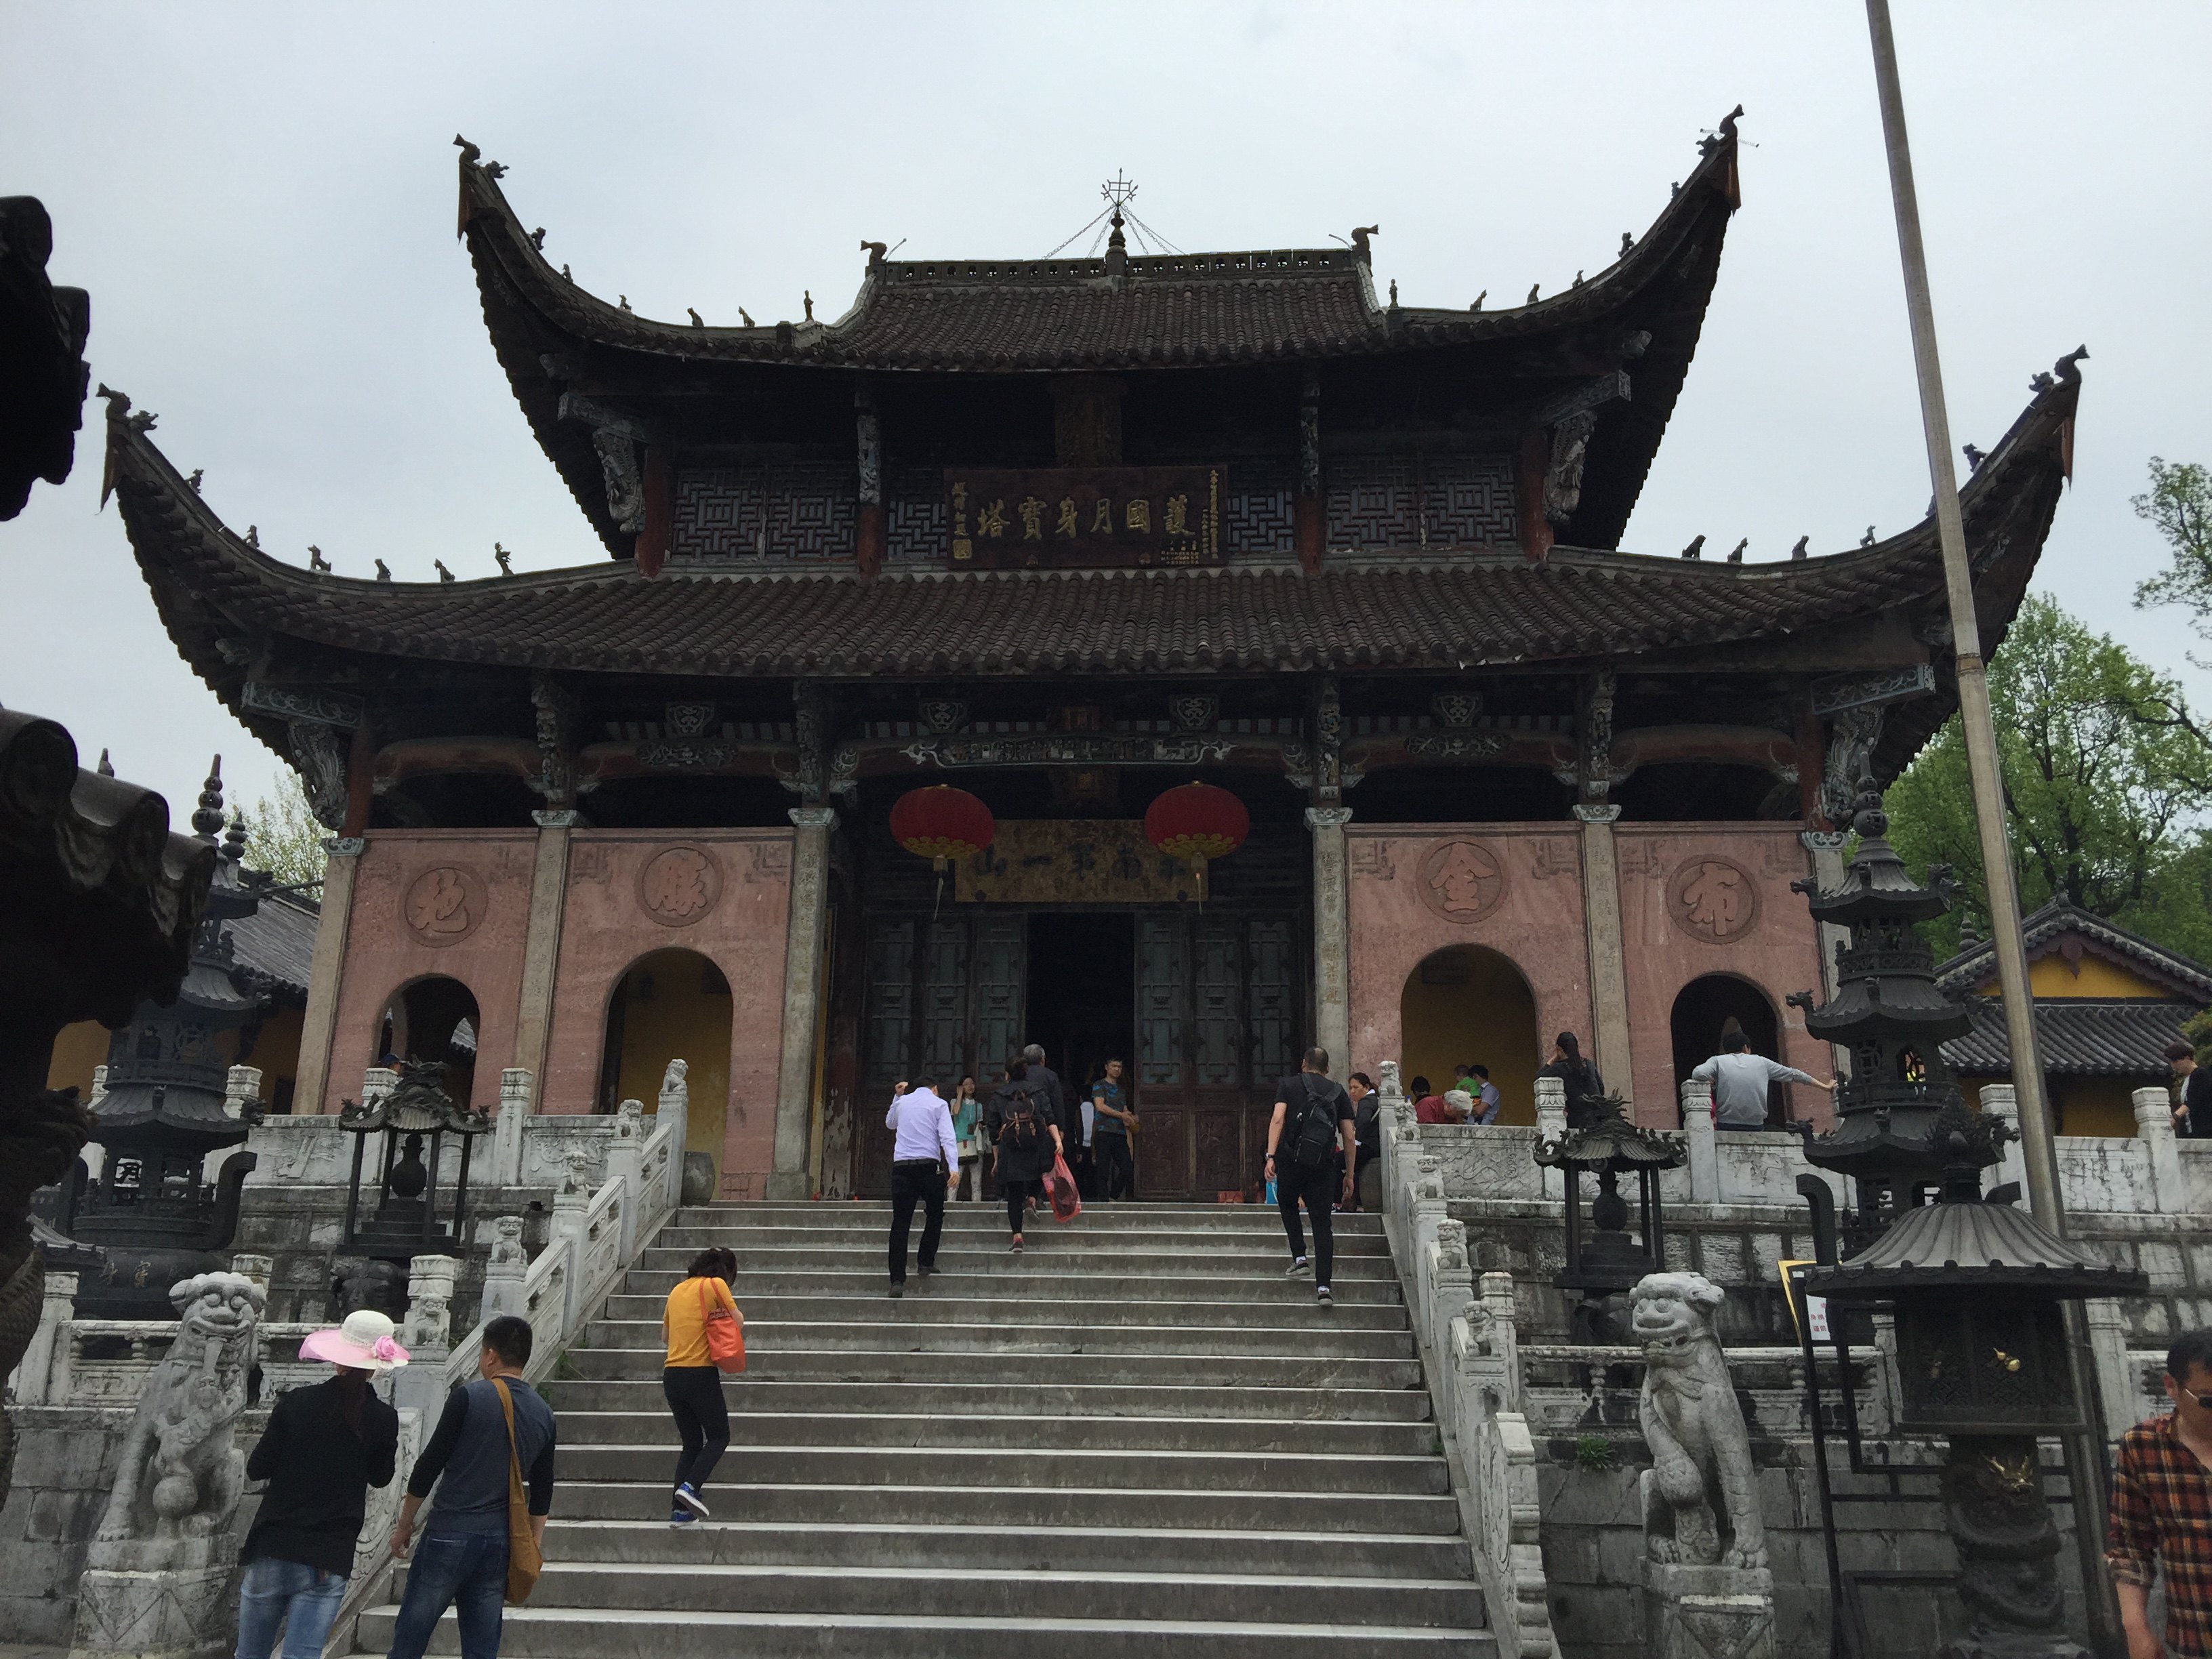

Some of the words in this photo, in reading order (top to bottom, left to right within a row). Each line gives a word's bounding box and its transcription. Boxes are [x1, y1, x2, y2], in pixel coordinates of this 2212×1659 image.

[977, 494, 1195, 541] 護國月身寶塔
